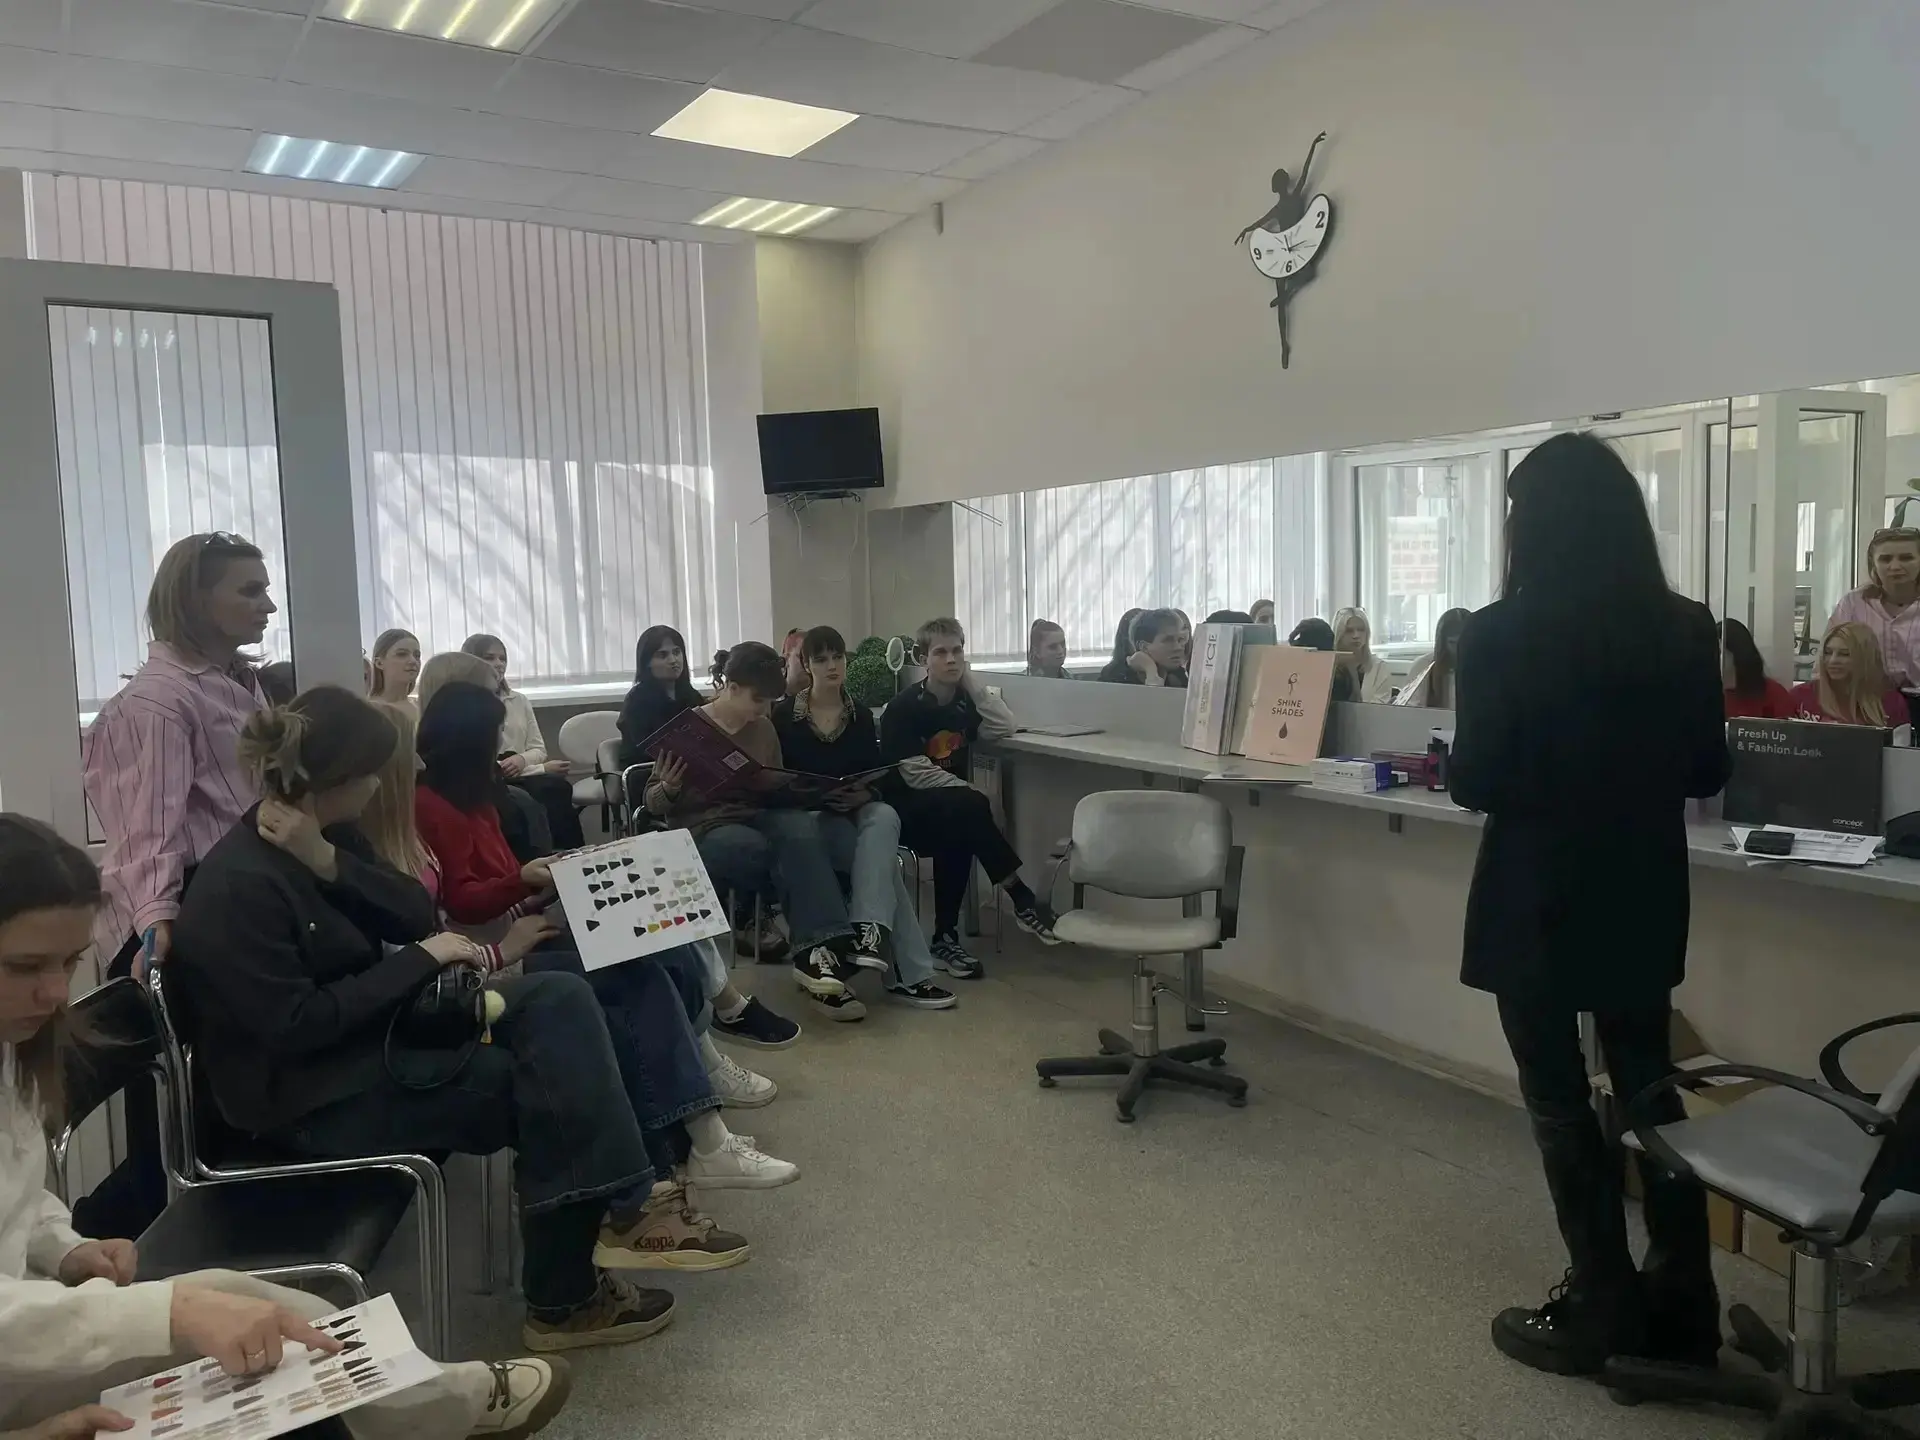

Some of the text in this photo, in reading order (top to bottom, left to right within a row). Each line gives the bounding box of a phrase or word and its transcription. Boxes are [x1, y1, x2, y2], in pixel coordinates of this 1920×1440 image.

[1315, 211, 1325, 228] 2
[1253, 248, 1262, 260] 9
[1285, 260, 1292, 273] 6
[1277, 698, 1303, 708] SHINE
[1271, 707, 1304, 717] SHADES
[1737, 727, 1787, 742] Fresh Up
[1736, 740, 1822, 758] & Fashion Look
[634, 1236, 675, 1251] Kappa
